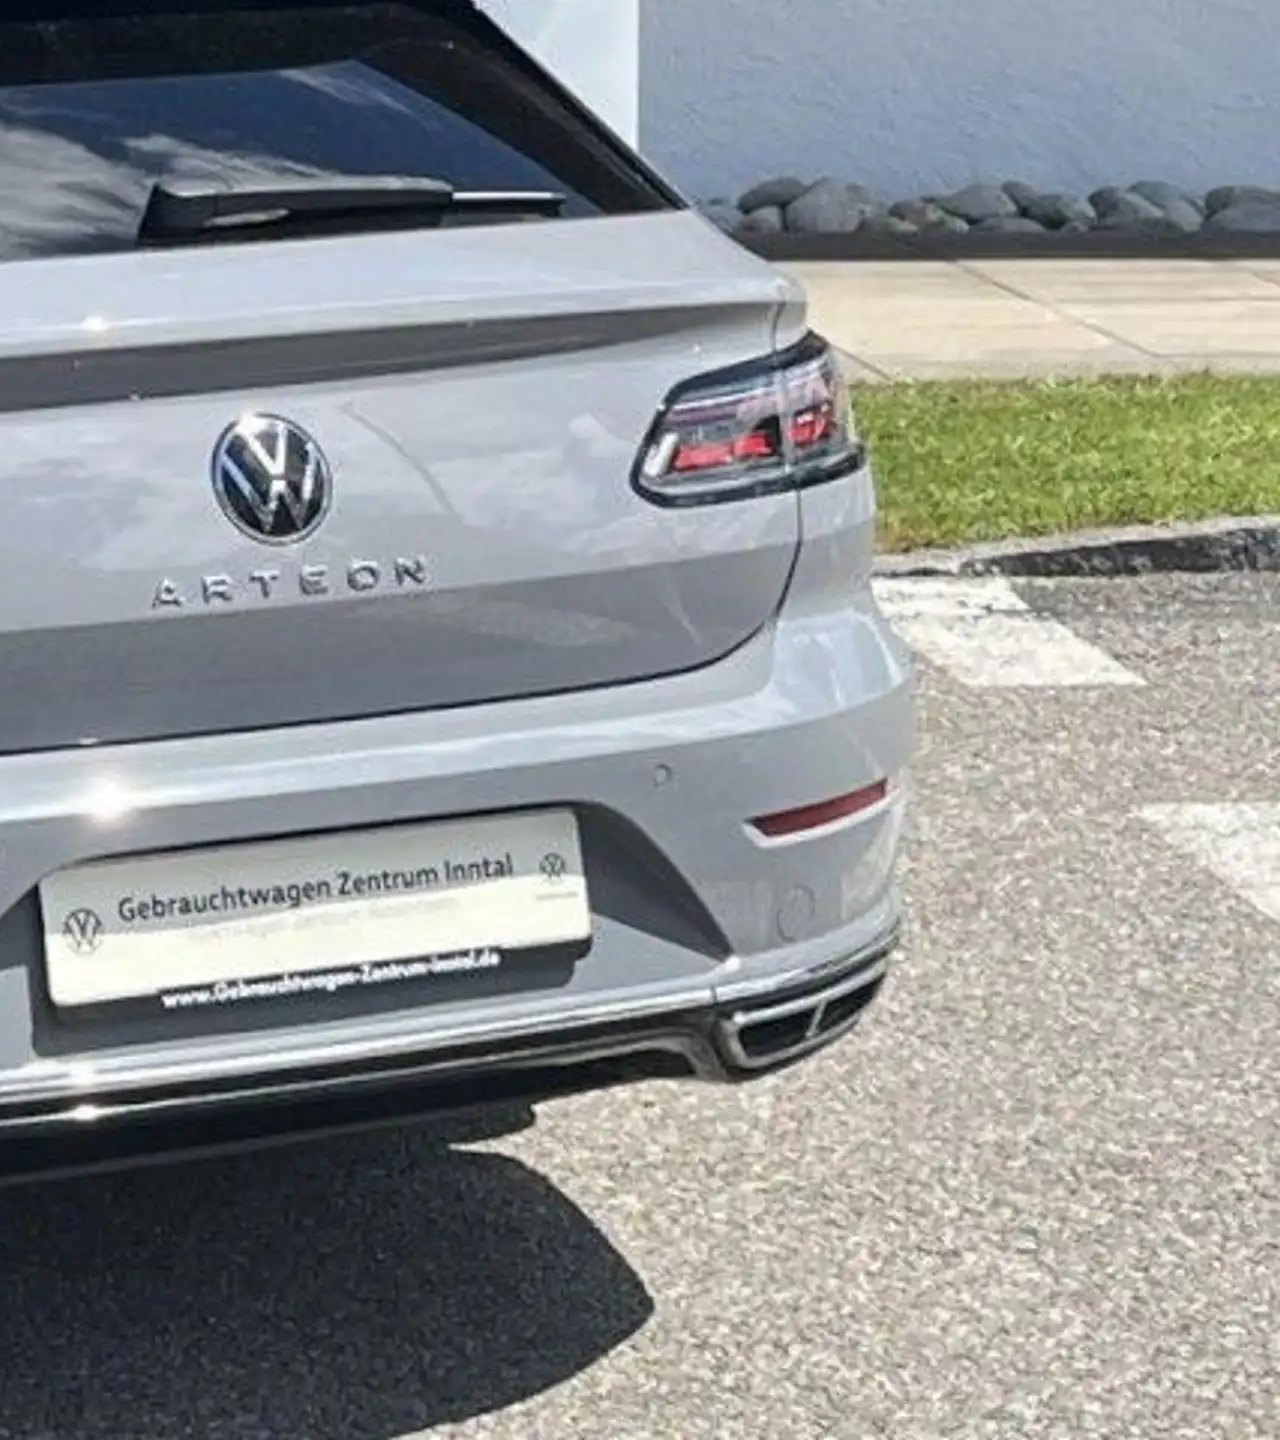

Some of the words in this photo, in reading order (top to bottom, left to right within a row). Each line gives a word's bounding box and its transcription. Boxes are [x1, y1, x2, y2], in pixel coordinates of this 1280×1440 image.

[210, 411, 333, 546] VW
[151, 555, 429, 609] ARTEON
[117, 879, 331, 923] Gebrauchtwagen
[339, 865, 439, 897] Zentrum
[444, 853, 515, 885] Inntal
